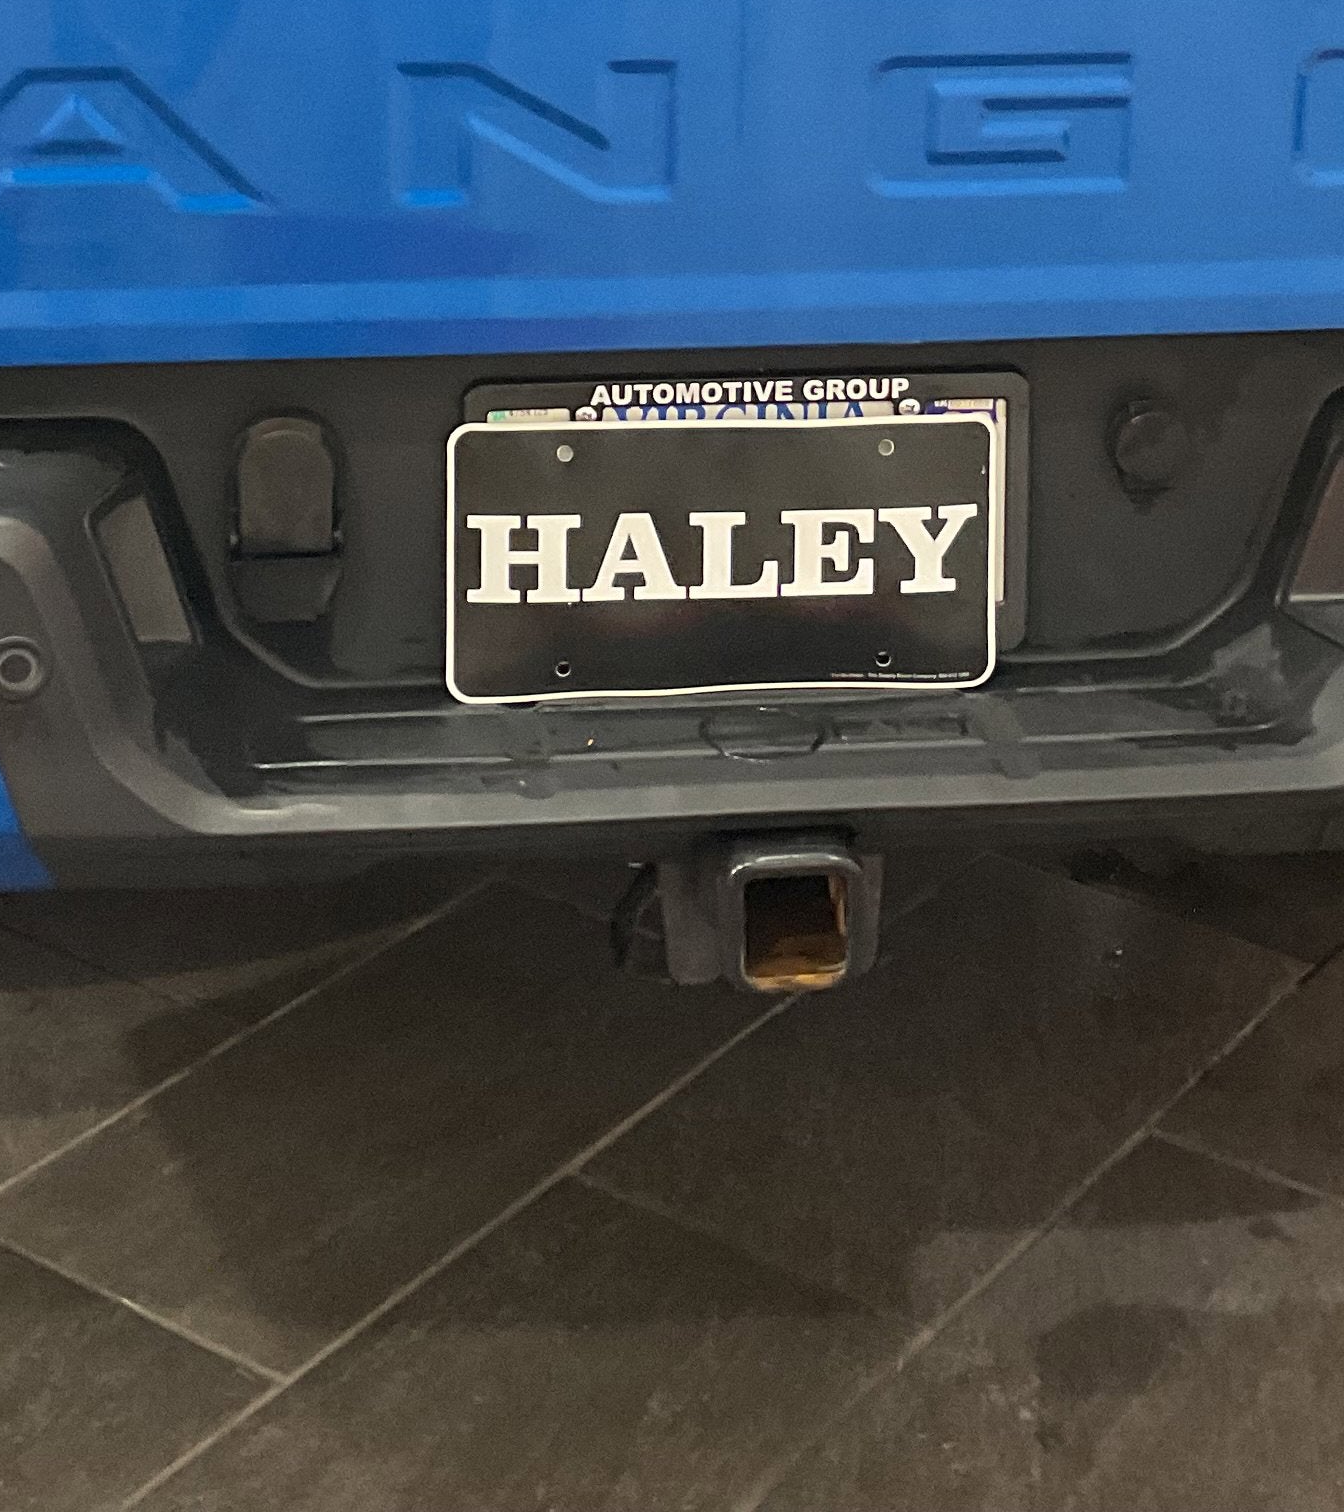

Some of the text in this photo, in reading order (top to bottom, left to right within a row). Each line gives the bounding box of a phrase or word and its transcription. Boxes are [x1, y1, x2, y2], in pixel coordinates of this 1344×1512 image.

[589, 377, 910, 406] AUTOMOTIVE GROUP
[464, 502, 979, 605] HALEY
